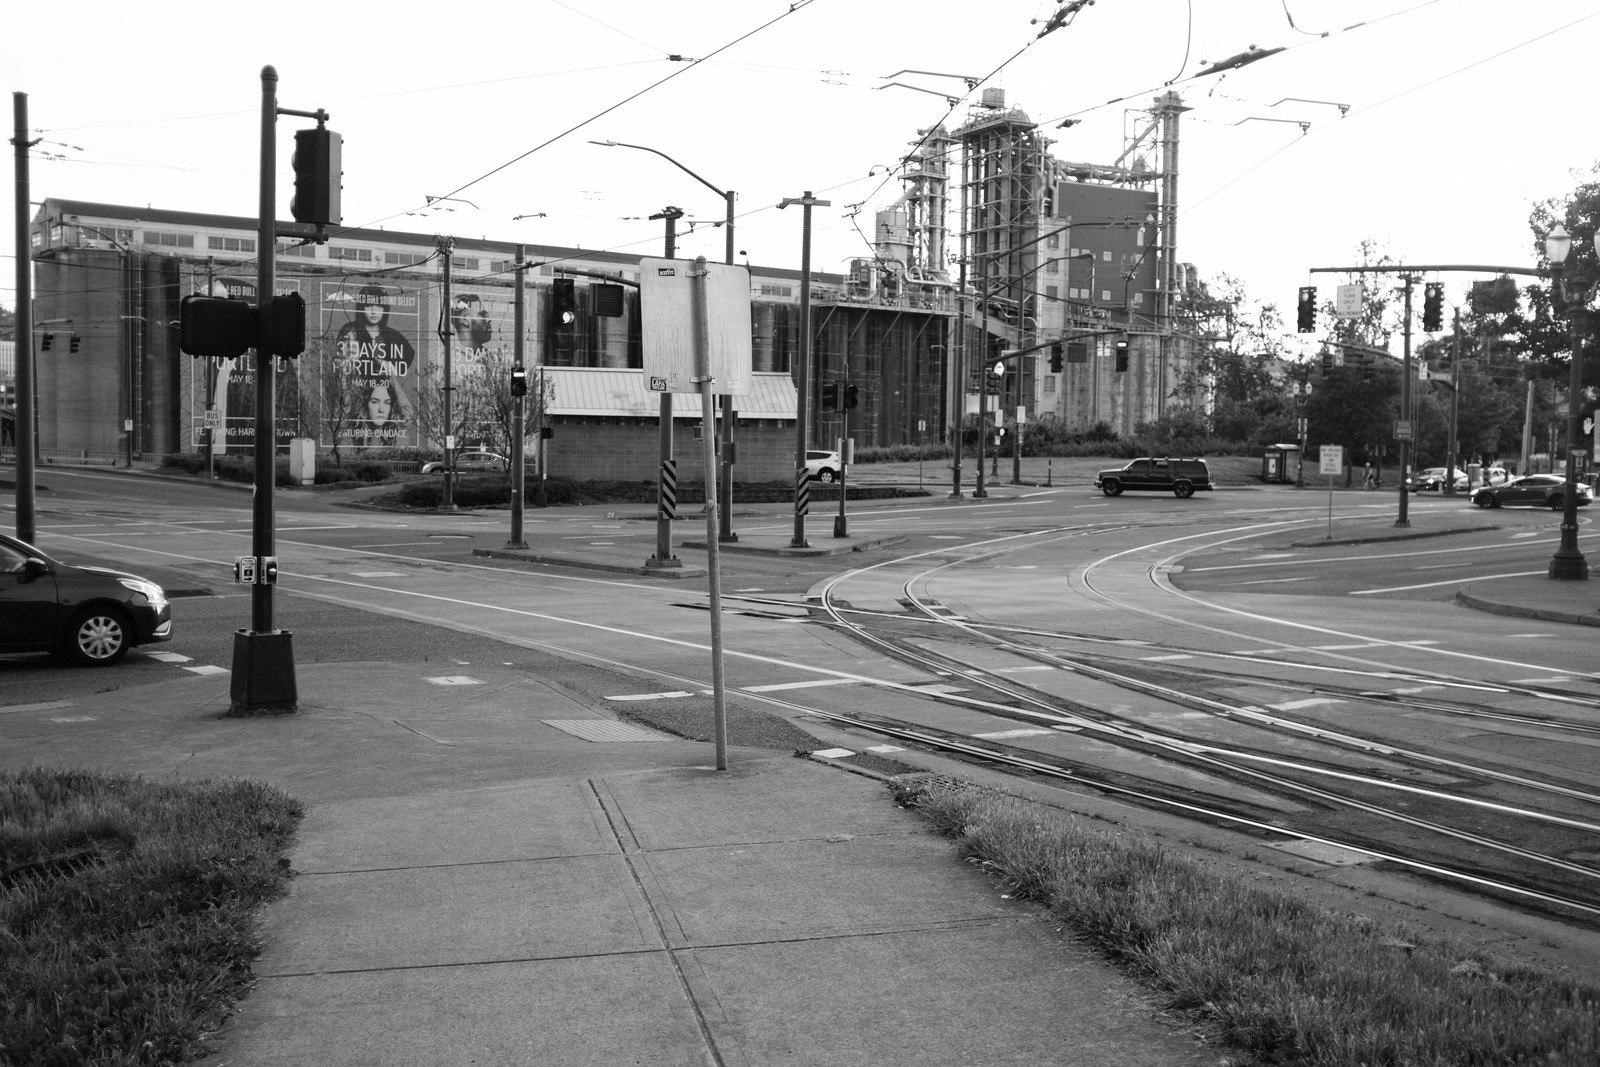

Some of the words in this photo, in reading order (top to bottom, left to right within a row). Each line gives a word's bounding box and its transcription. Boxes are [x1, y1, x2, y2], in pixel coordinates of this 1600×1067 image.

[230, 285, 241, 295] RED
[242, 286, 256, 296] BULL
[355, 293, 366, 303] RED
[366, 294, 379, 304] BULL
[380, 296, 397, 305] SOUND
[397, 296, 415, 306] SELECT
[336, 341, 346, 356] 3
[350, 341, 387, 359] DAYS
[390, 343, 403, 359] IN
[454, 347, 462, 362] 3
[333, 359, 408, 377] PORTLAND
[351, 379, 368, 388] MAY
[368, 379, 390, 389] 18-20
[374, 429, 408, 438] CANDACE
